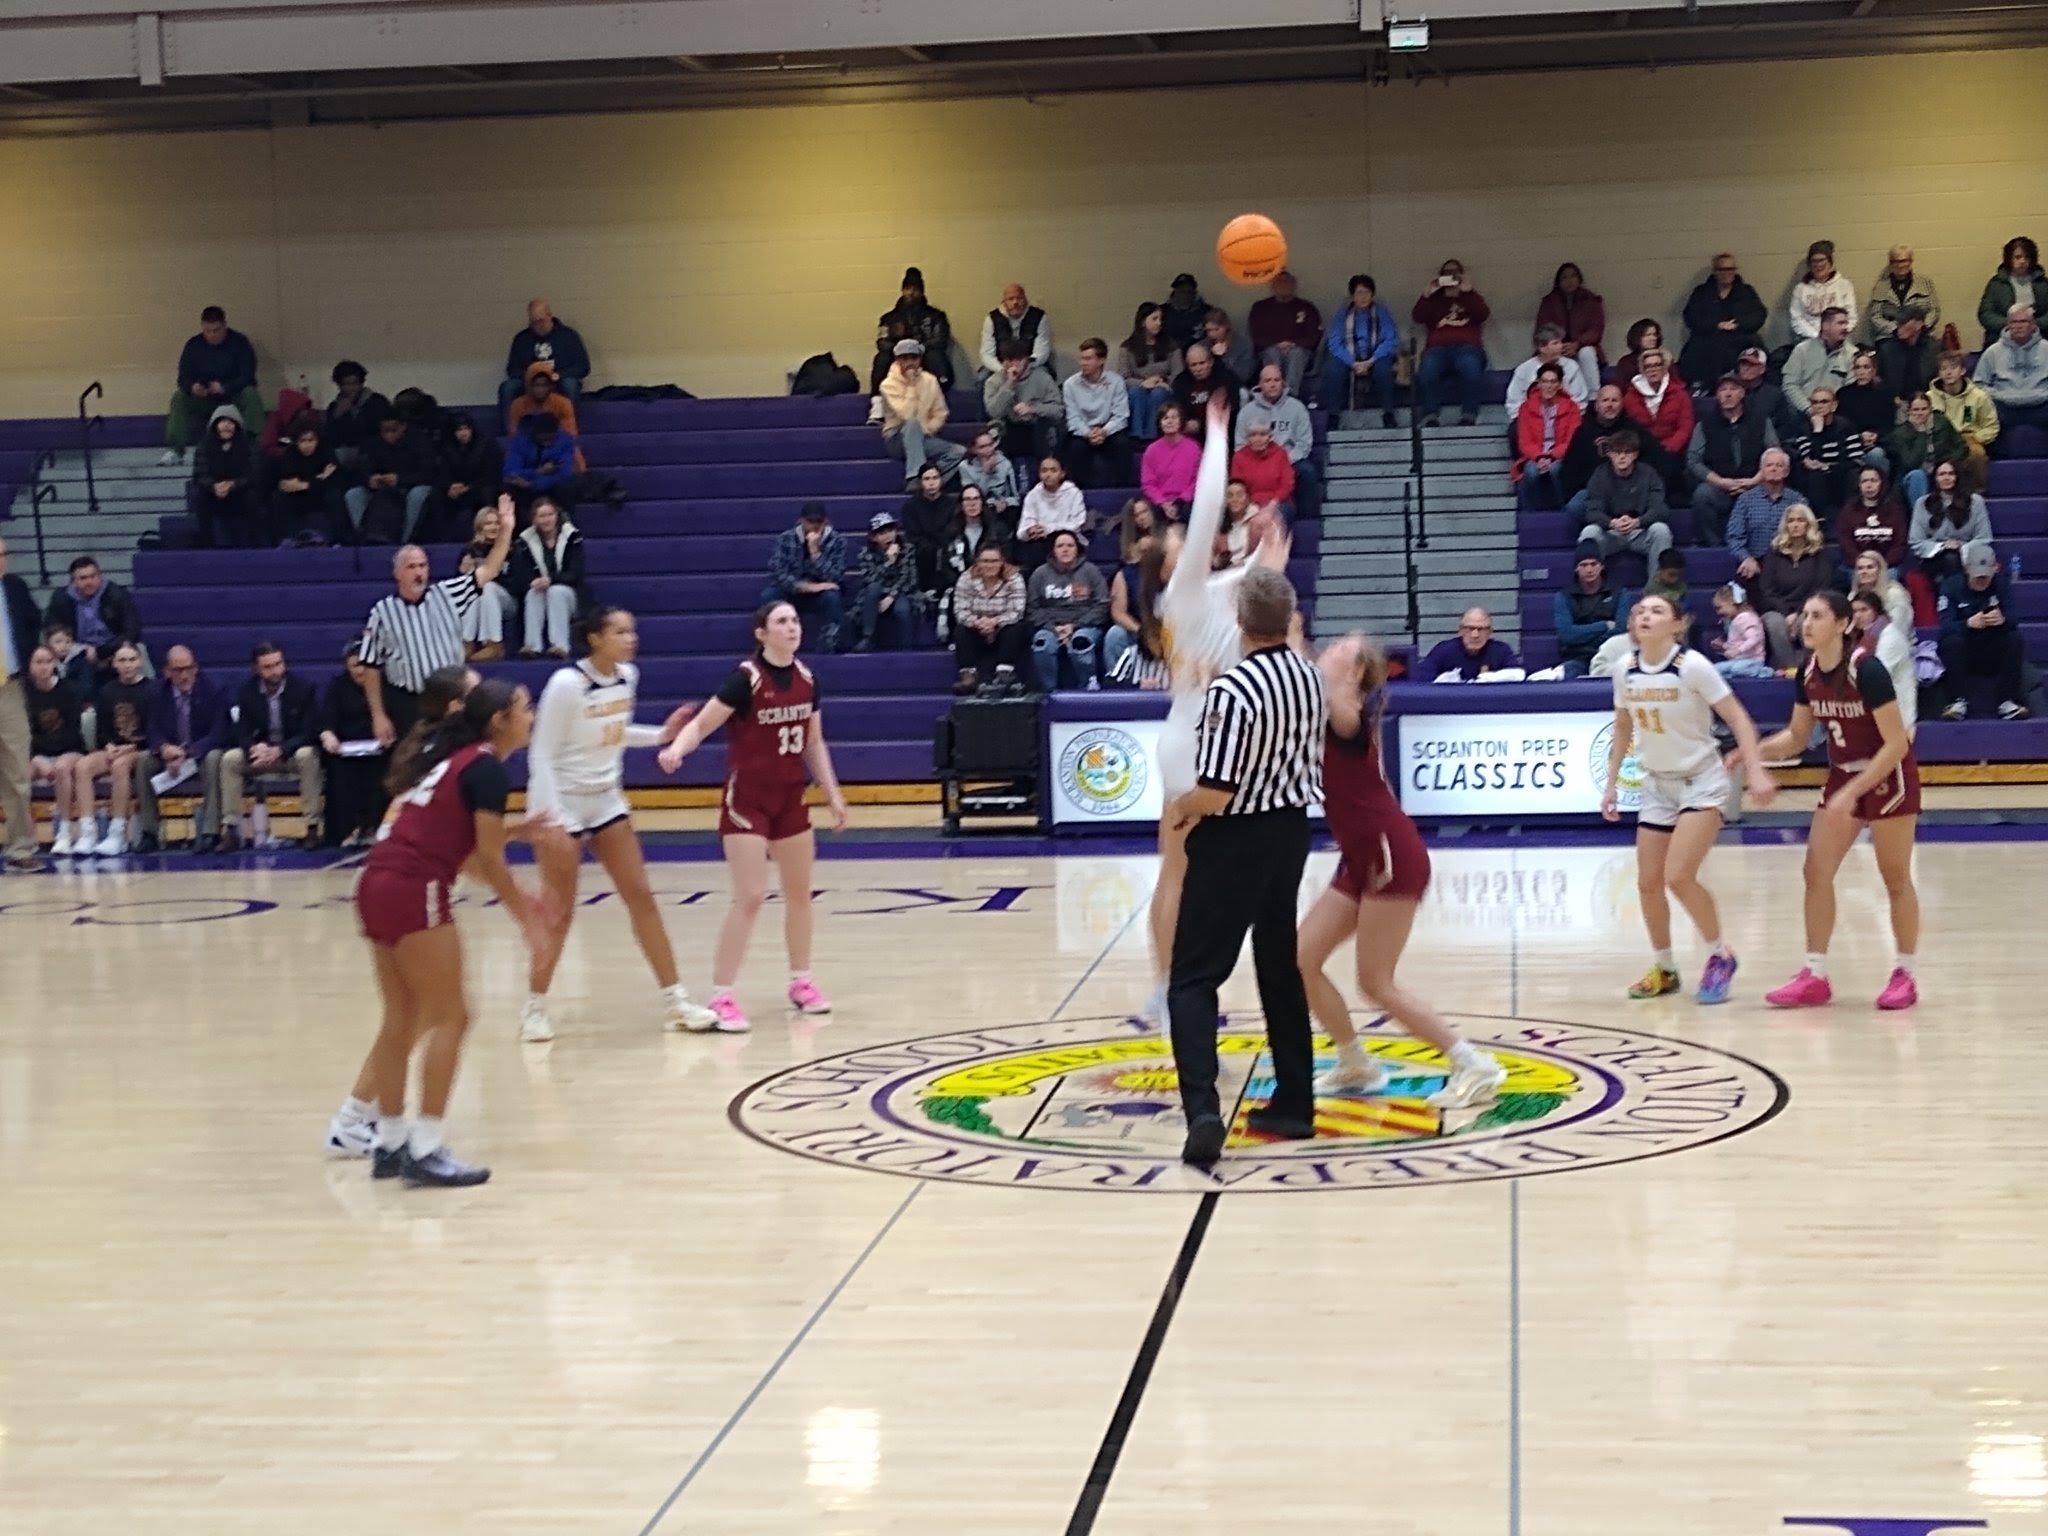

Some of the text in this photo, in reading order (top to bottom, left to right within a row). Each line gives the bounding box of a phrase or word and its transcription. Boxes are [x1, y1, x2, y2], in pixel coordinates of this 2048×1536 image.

[777, 724, 804, 756] 33
[1827, 719, 1847, 748] 2
[1412, 739, 1569, 760] SCRANTON PREP
[1412, 761, 1568, 791] CLASSICS
[751, 1034, 1045, 1113] SCHOOL
[1519, 1027, 1749, 1145] SCRANTON
